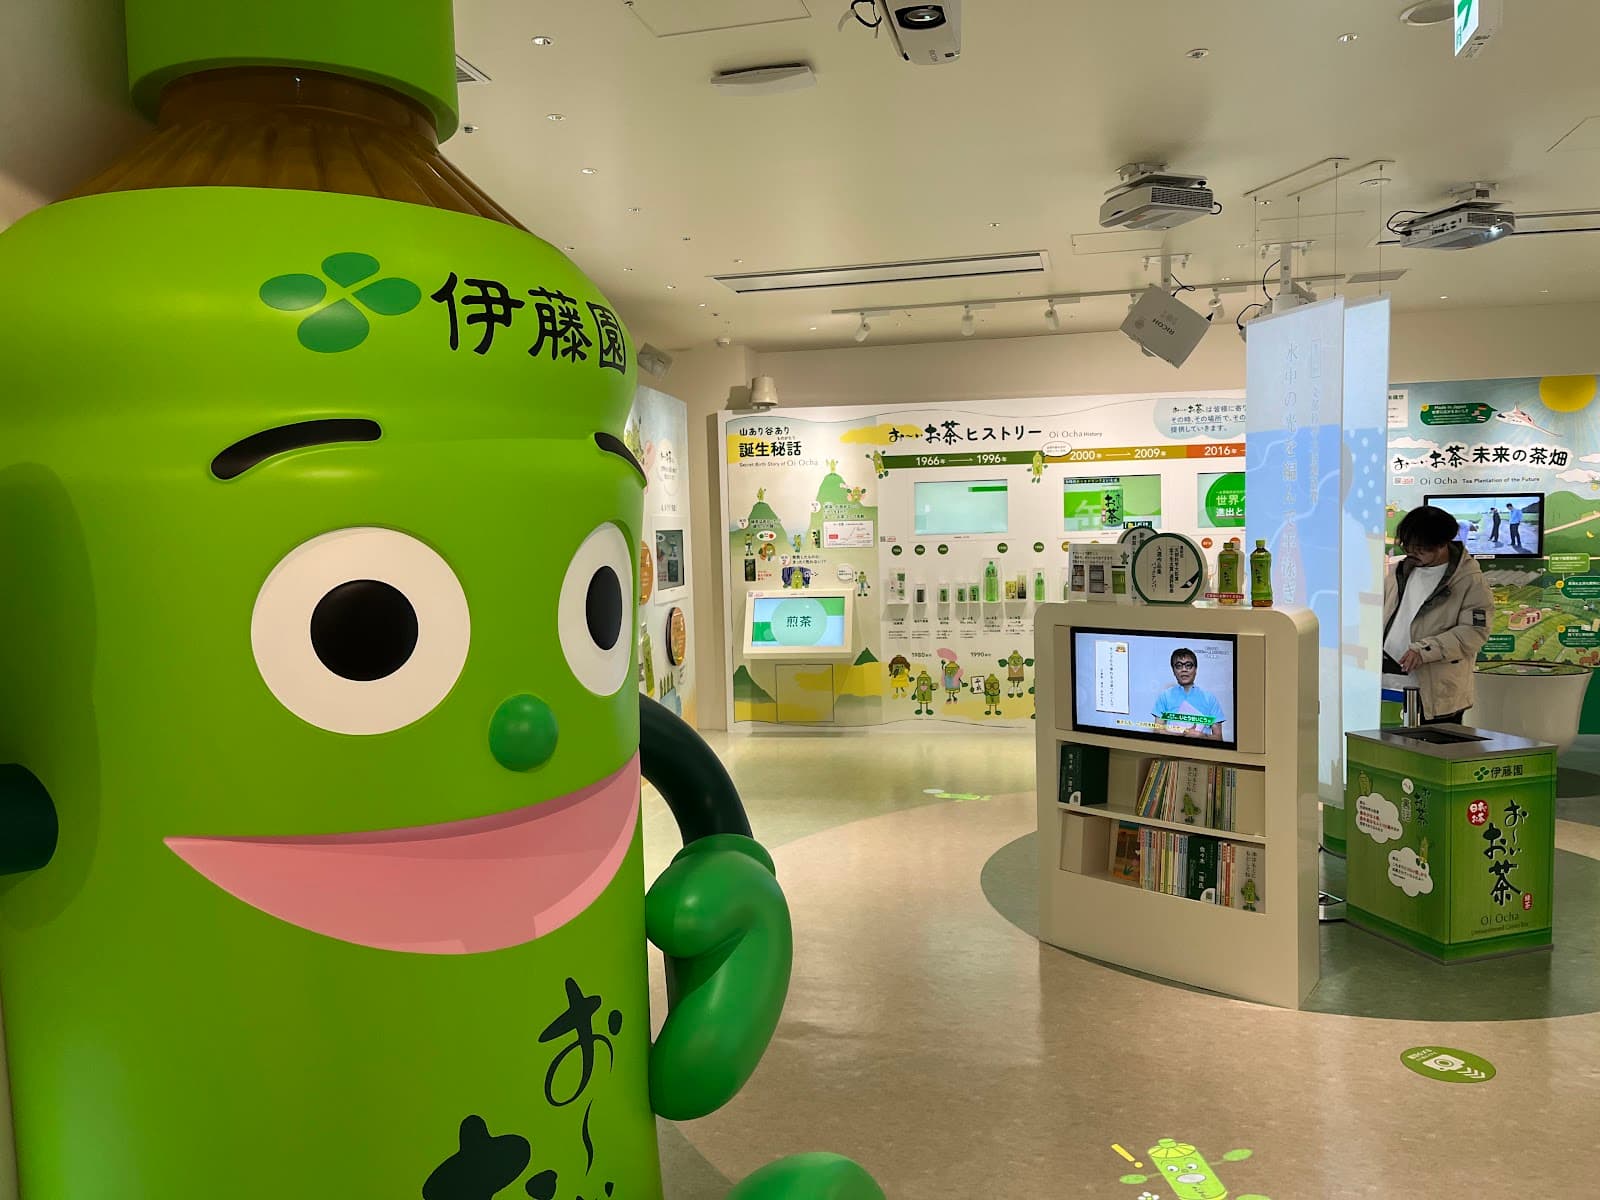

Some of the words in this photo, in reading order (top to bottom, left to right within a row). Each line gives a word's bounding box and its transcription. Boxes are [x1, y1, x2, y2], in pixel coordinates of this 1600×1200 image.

[431, 271, 626, 375] 伊藤園
[1152, 318, 1175, 336] RICOH
[740, 427, 790, 437] 山あり谷あり
[1061, 430, 1083, 438] Ocha
[739, 441, 802, 457] 誕生秘話
[1420, 477, 1431, 487] Oi
[1434, 477, 1458, 486] Ocha
[787, 616, 812, 628] 煎茶
[1491, 764, 1523, 778] 伊藤園
[1482, 822, 1522, 906] お茶
[1480, 915, 1492, 926] Oi
[1495, 911, 1520, 923] Ocha
